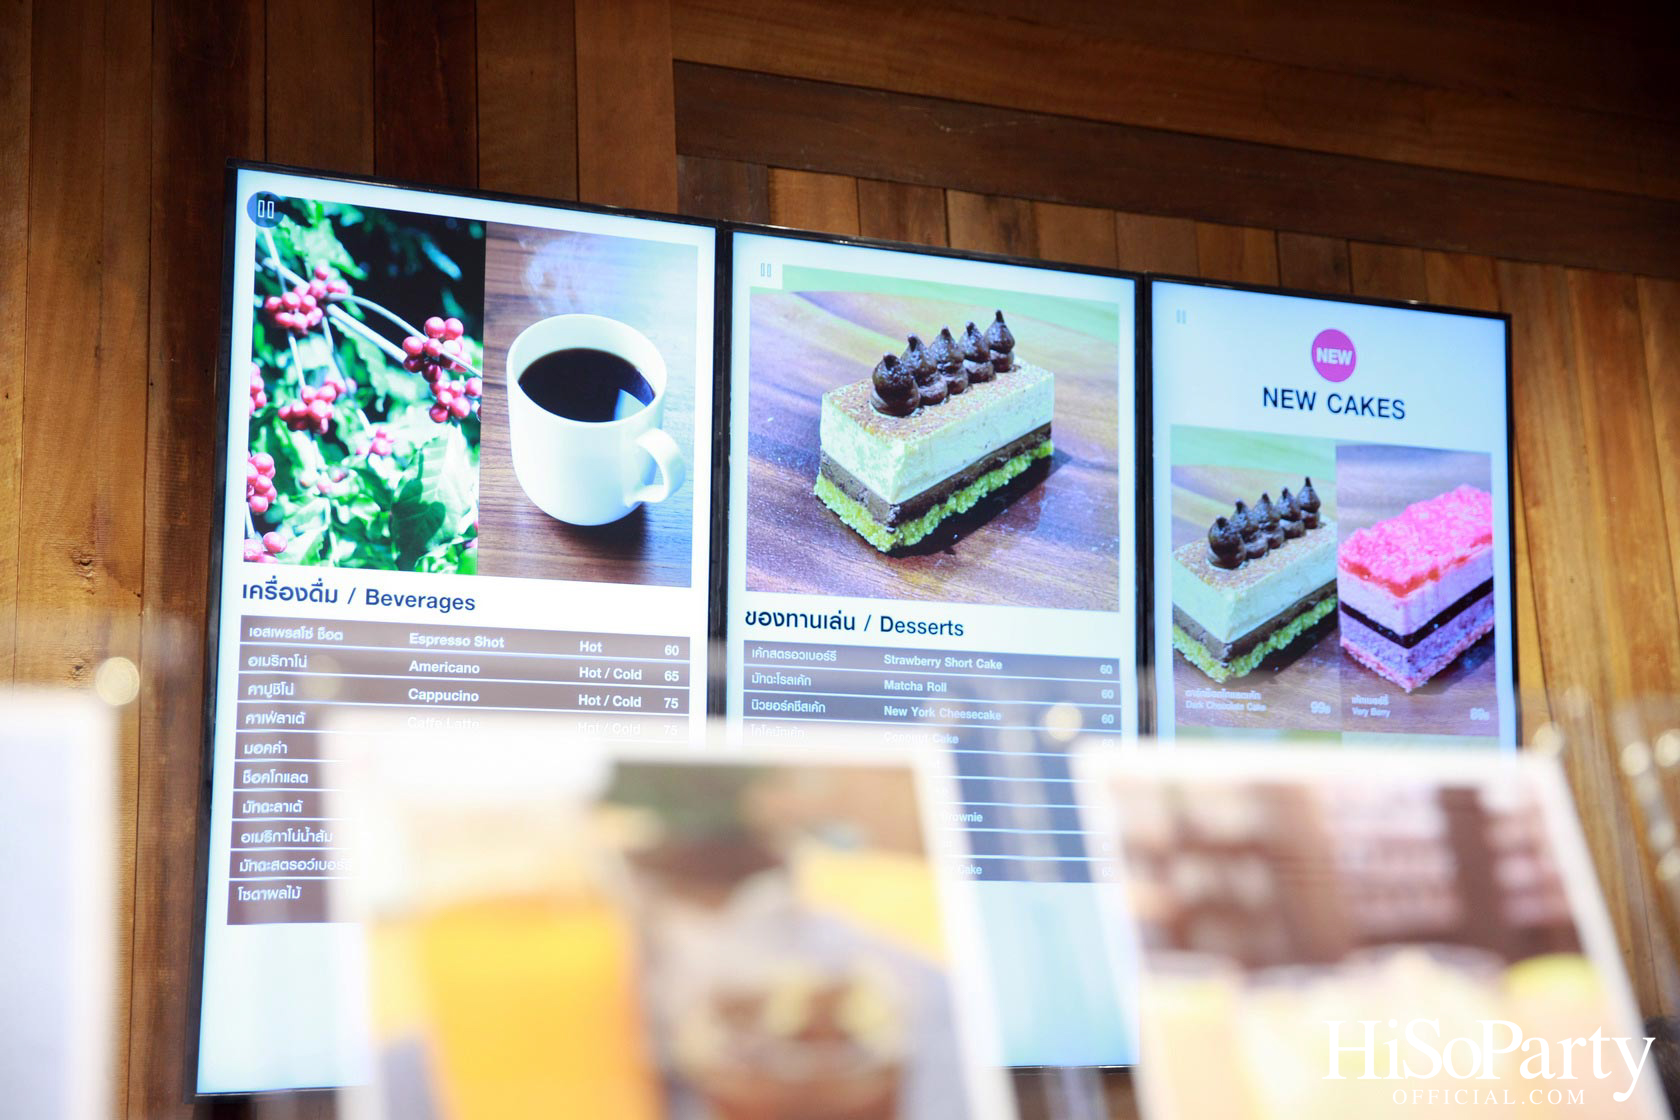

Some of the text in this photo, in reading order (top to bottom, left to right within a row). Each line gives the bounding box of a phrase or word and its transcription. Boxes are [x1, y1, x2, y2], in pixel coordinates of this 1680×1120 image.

[1316, 347, 1353, 365] NEW
[1263, 387, 1405, 419] NEW CAKES
[242, 575, 476, 613] เครื่องดื่ม / Beverages
[745, 609, 964, 637] ของทานเล่น / Desserts
[409, 632, 505, 649] Espresso Shot
[579, 640, 602, 653] Hot
[664, 645, 680, 657] 60
[248, 653, 308, 668] อเมริกาโน่
[409, 660, 480, 675] Americano
[884, 654, 1003, 670] Strawberry Short Cake
[579, 667, 602, 679] Hot
[613, 668, 642, 681] Cold
[664, 671, 680, 682] 65
[1100, 664, 1113, 675] 60
[884, 680, 947, 692] Matcha Roll
[408, 688, 479, 704] Cappucino
[578, 694, 602, 706] Hot
[612, 695, 642, 708] Cold
[1101, 689, 1114, 699] 60
[664, 698, 679, 709] 75
[245, 711, 305, 725] คาเฟ่ลาเต้
[884, 705, 1002, 720] New York Cheesecake
[1101, 714, 1114, 725] 60
[932, 734, 959, 745] Cake
[244, 741, 287, 755] มอคค่า
[242, 799, 303, 814] มัทฉะลาเต้
[241, 827, 332, 844] อเมริกาโน่น้ำส้ม
